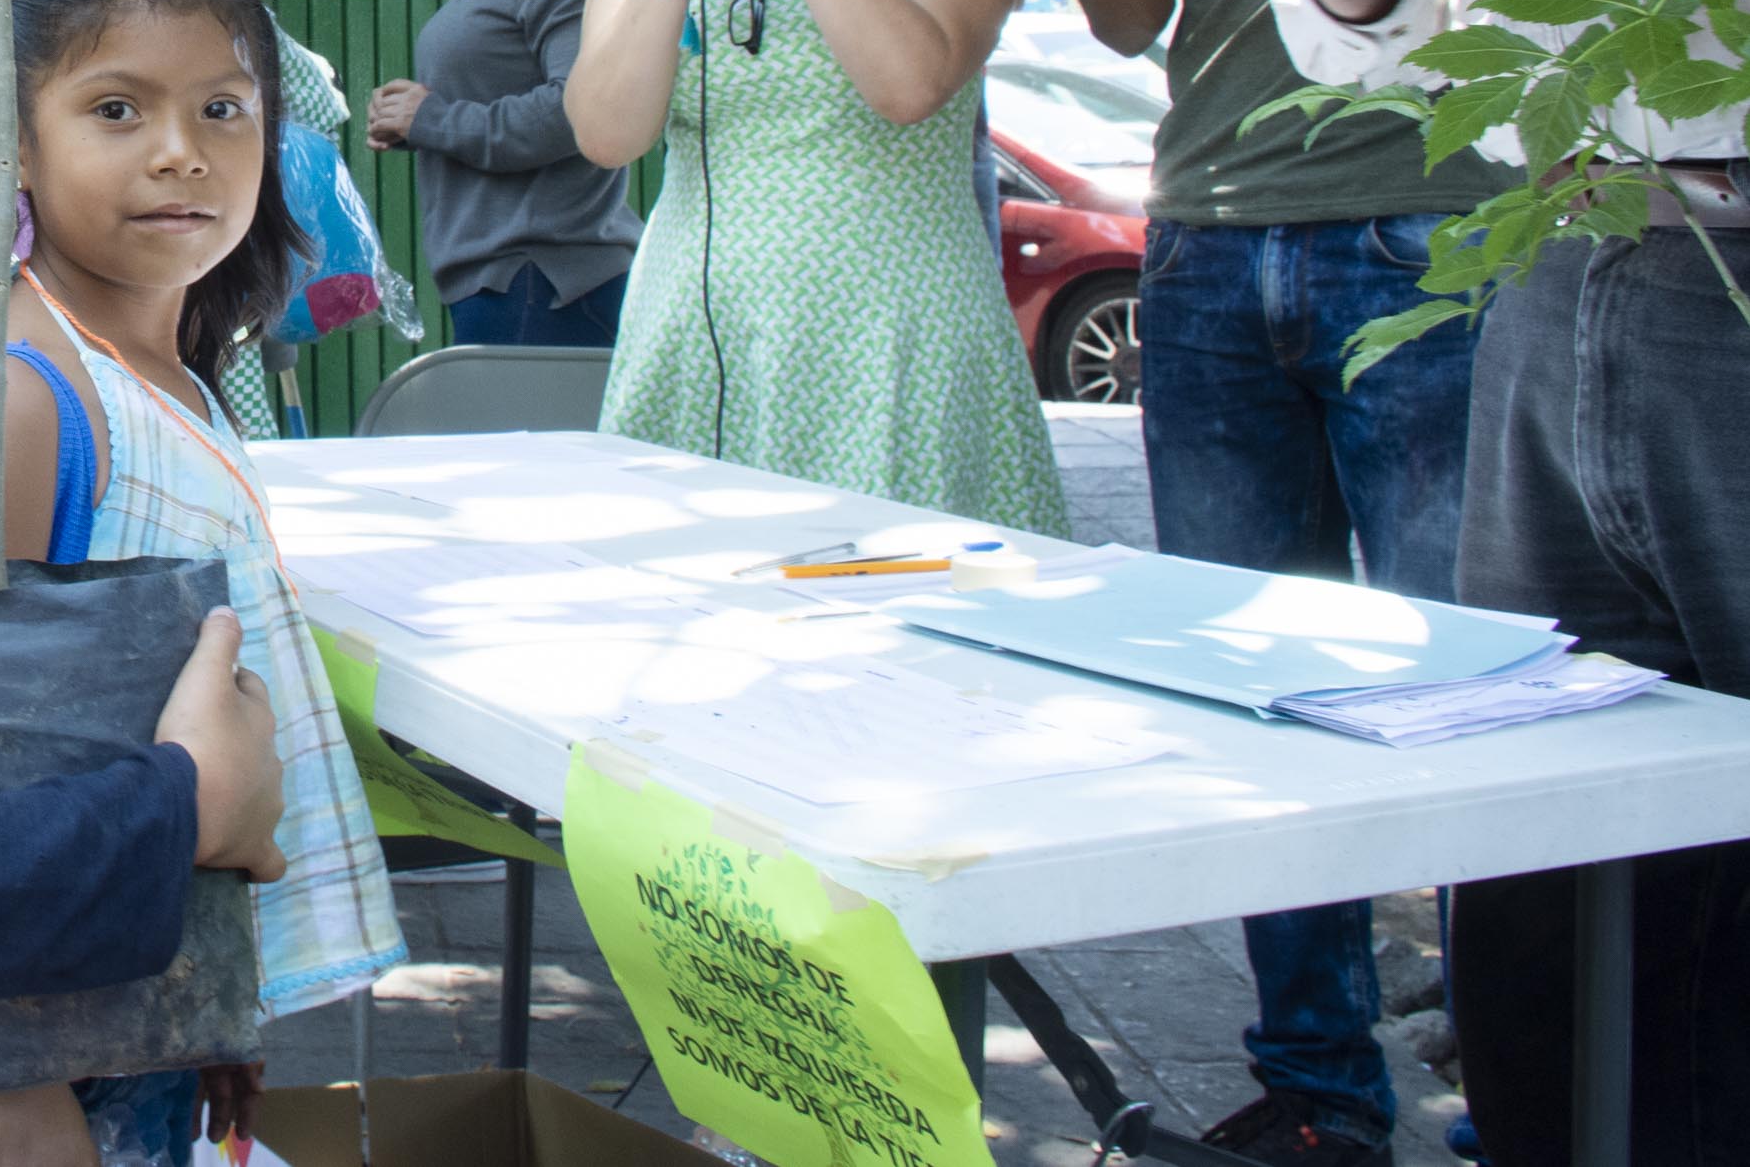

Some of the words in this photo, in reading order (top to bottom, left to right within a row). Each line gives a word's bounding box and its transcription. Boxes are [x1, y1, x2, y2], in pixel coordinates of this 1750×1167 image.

[635, 874, 678, 921] NO
[685, 901, 802, 980] SOMOS
[803, 959, 856, 1007] DE
[690, 955, 845, 1045] DERECHA
[667, 1027, 782, 1102] SOMOS
[784, 1086, 833, 1128] DE
[832, 1106, 881, 1156] LA
[668, 987, 707, 1027] NI
[707, 1004, 755, 1048] DE
[754, 1028, 941, 1145] IZQUIERDA
